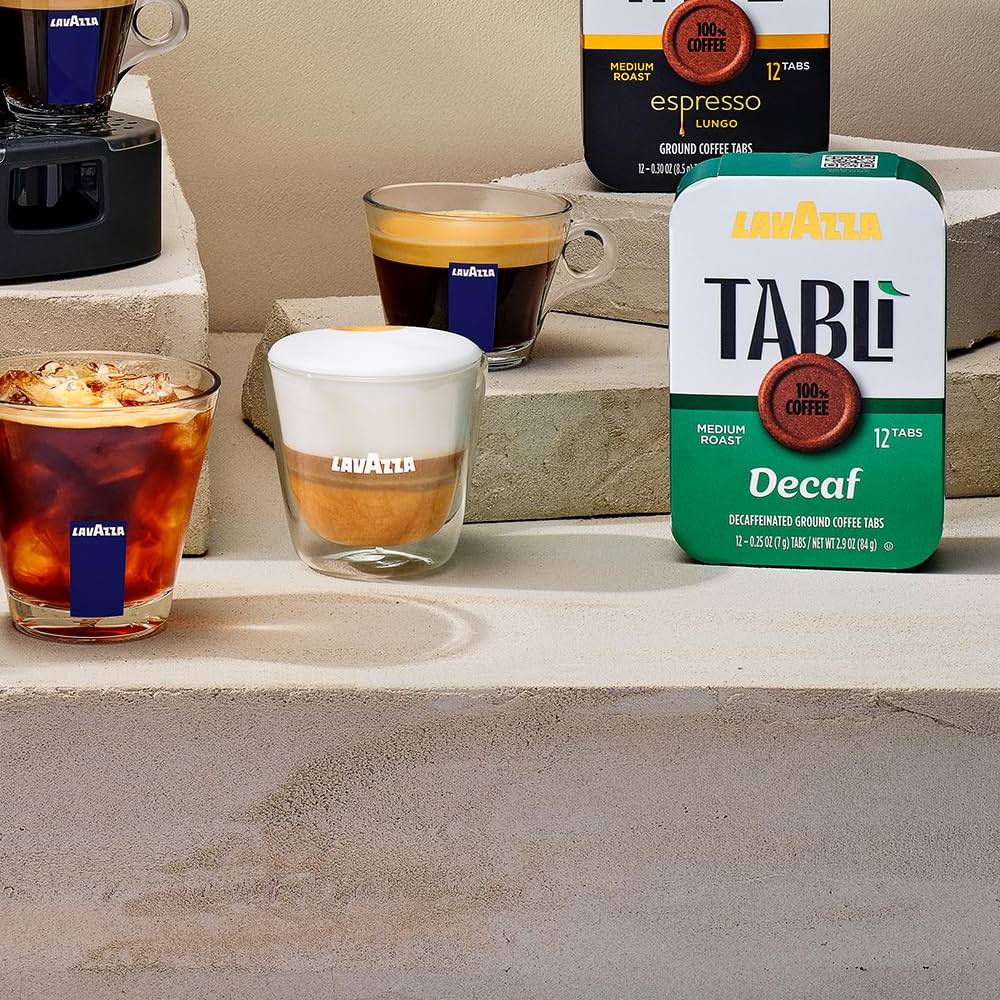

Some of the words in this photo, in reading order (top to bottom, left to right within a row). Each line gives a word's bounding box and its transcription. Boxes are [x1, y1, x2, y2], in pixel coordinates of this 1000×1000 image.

[50, 15, 99, 27] LAVAZZA
[697, 22, 727, 37] 100%
[687, 38, 727, 52] COFFEE
[610, 62, 654, 71] MEDIUM
[766, 62, 781, 81] 12
[782, 61, 811, 71] TABS
[613, 72, 651, 81] ROAST
[650, 95, 761, 126] espresso
[695, 119, 738, 129] LUNGO
[660, 142, 697, 155] GROUND
[699, 142, 729, 155] COFFEE
[731, 142, 753, 154] TABS
[731, 201, 884, 241] LAVAZZA
[452, 266, 495, 278] LAVAZZA
[796, 383, 829, 399] 100%
[786, 400, 829, 416] COFFEE
[697, 424, 745, 435] MEDIUM
[701, 435, 742, 446] ROAST
[874, 428, 889, 449] 12
[891, 428, 923, 438] TABS
[331, 453, 416, 474] LAVAZZA
[749, 467, 864, 499] Decaf
[729, 514, 793, 527] DECAFFEINATED
[795, 516, 830, 528] GROUND
[833, 516, 862, 528] COFFEE
[863, 517, 884, 529] TABS
[72, 524, 125, 536] LAVAZZA
[791, 536, 806, 549] TABS
[812, 537, 824, 549] NET
[825, 537, 836, 549] WT
